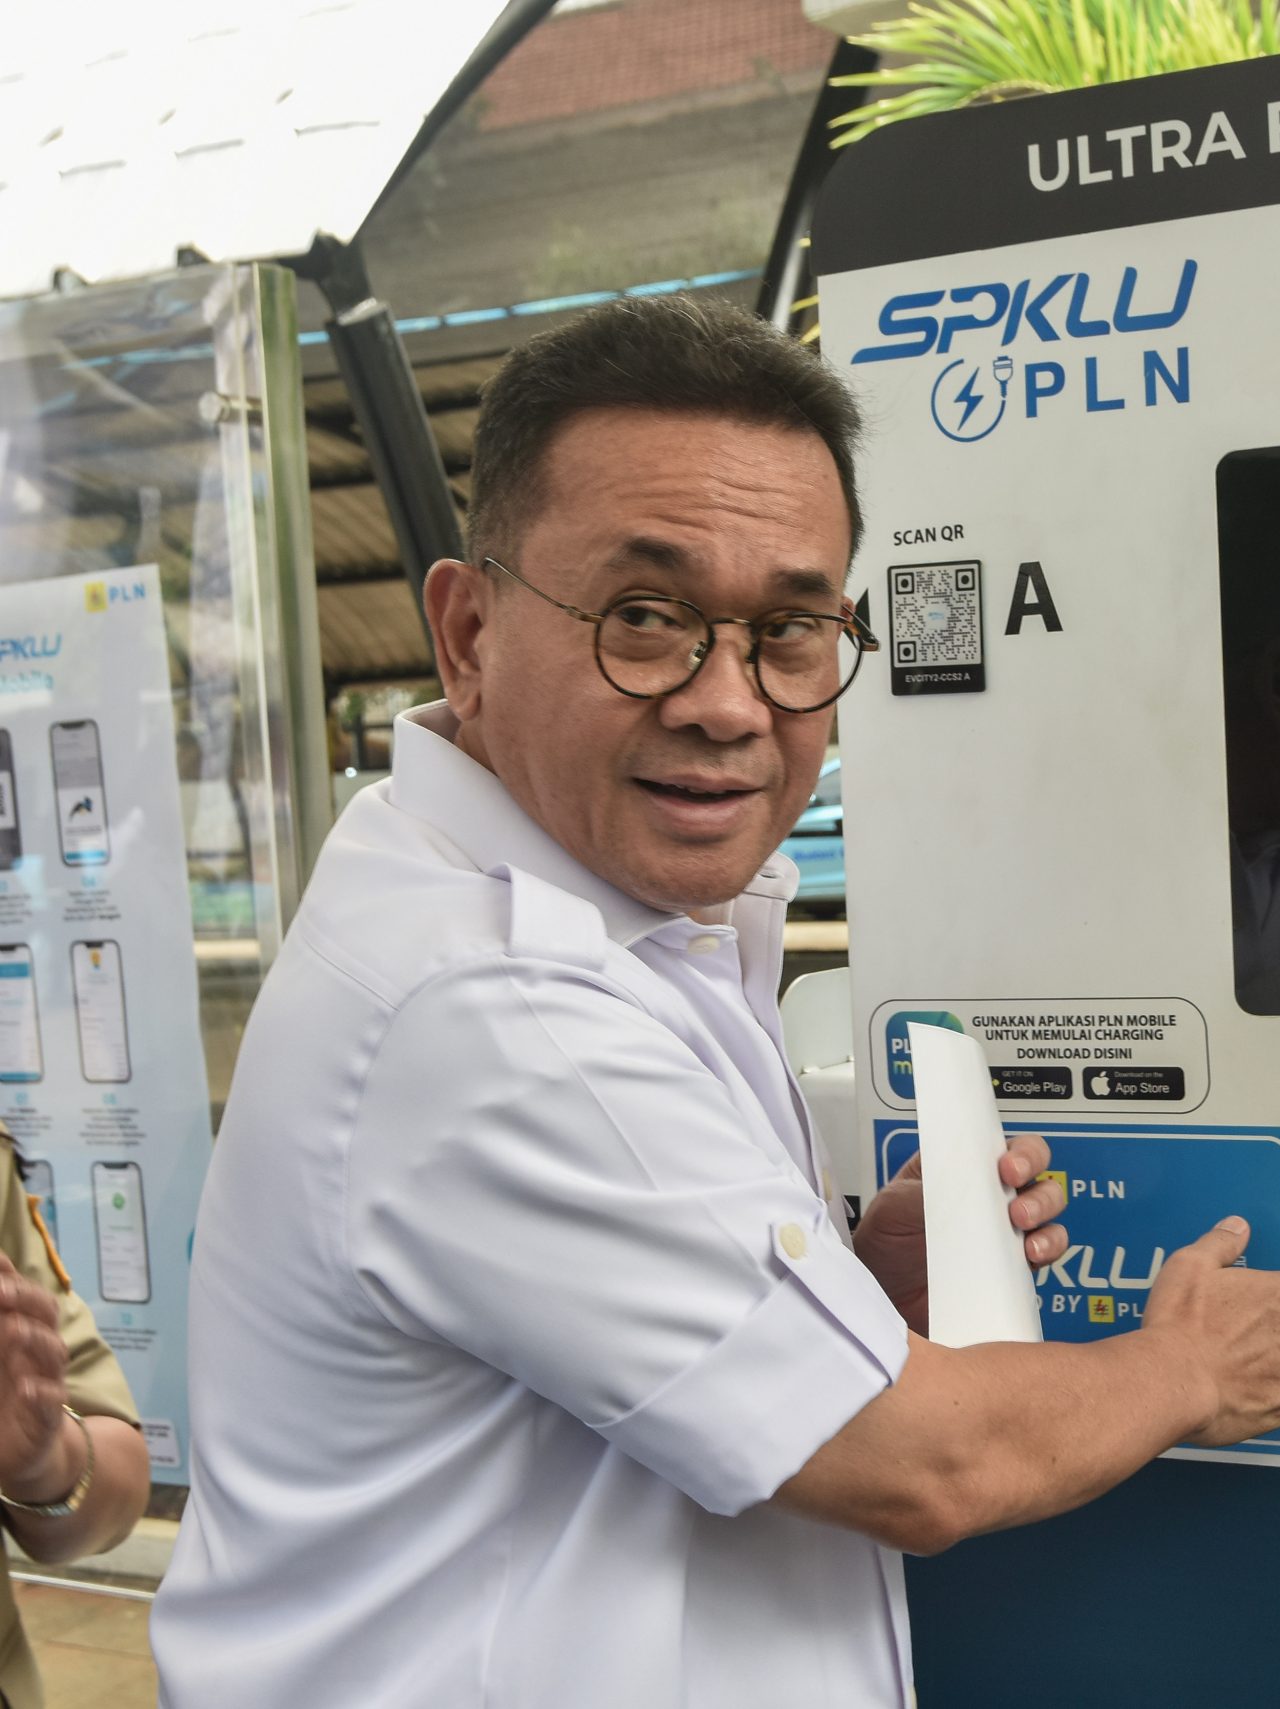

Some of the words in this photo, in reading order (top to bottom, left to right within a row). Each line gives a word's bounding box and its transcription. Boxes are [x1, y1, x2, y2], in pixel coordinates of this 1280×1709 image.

[1027, 111, 1246, 192] ULTRA
[850, 259, 1198, 364] SPKLU
[1025, 347, 1190, 418] PLN
[893, 527, 936, 546] SCAN
[941, 524, 964, 540] QR
[108, 583, 145, 603] PLN
[1004, 561, 1064, 635] A
[905, 673, 962, 683] EVCITY2-CCS2
[964, 672, 970, 680] A
[972, 1015, 1035, 1027] GUNAKAN
[1038, 1015, 1095, 1027] APLIKASI
[1099, 1015, 1123, 1026] PLN
[1126, 1014, 1176, 1026] MOBILE
[985, 1029, 1029, 1041] UNTUK
[1032, 1029, 1092, 1040] MEMULAI
[1095, 1029, 1164, 1040] CHARGING
[1017, 1047, 1091, 1059] DOWNLOAD
[1094, 1048, 1133, 1059] DISINI
[1003, 1081, 1040, 1094] Google
[1043, 1081, 1067, 1095] Play
[1115, 1082, 1138, 1095] App
[1140, 1082, 1170, 1093] Store
[1072, 1180, 1125, 1199] PLN
[1052, 1294, 1082, 1313] BY
[1118, 1303, 1143, 1318] PL
